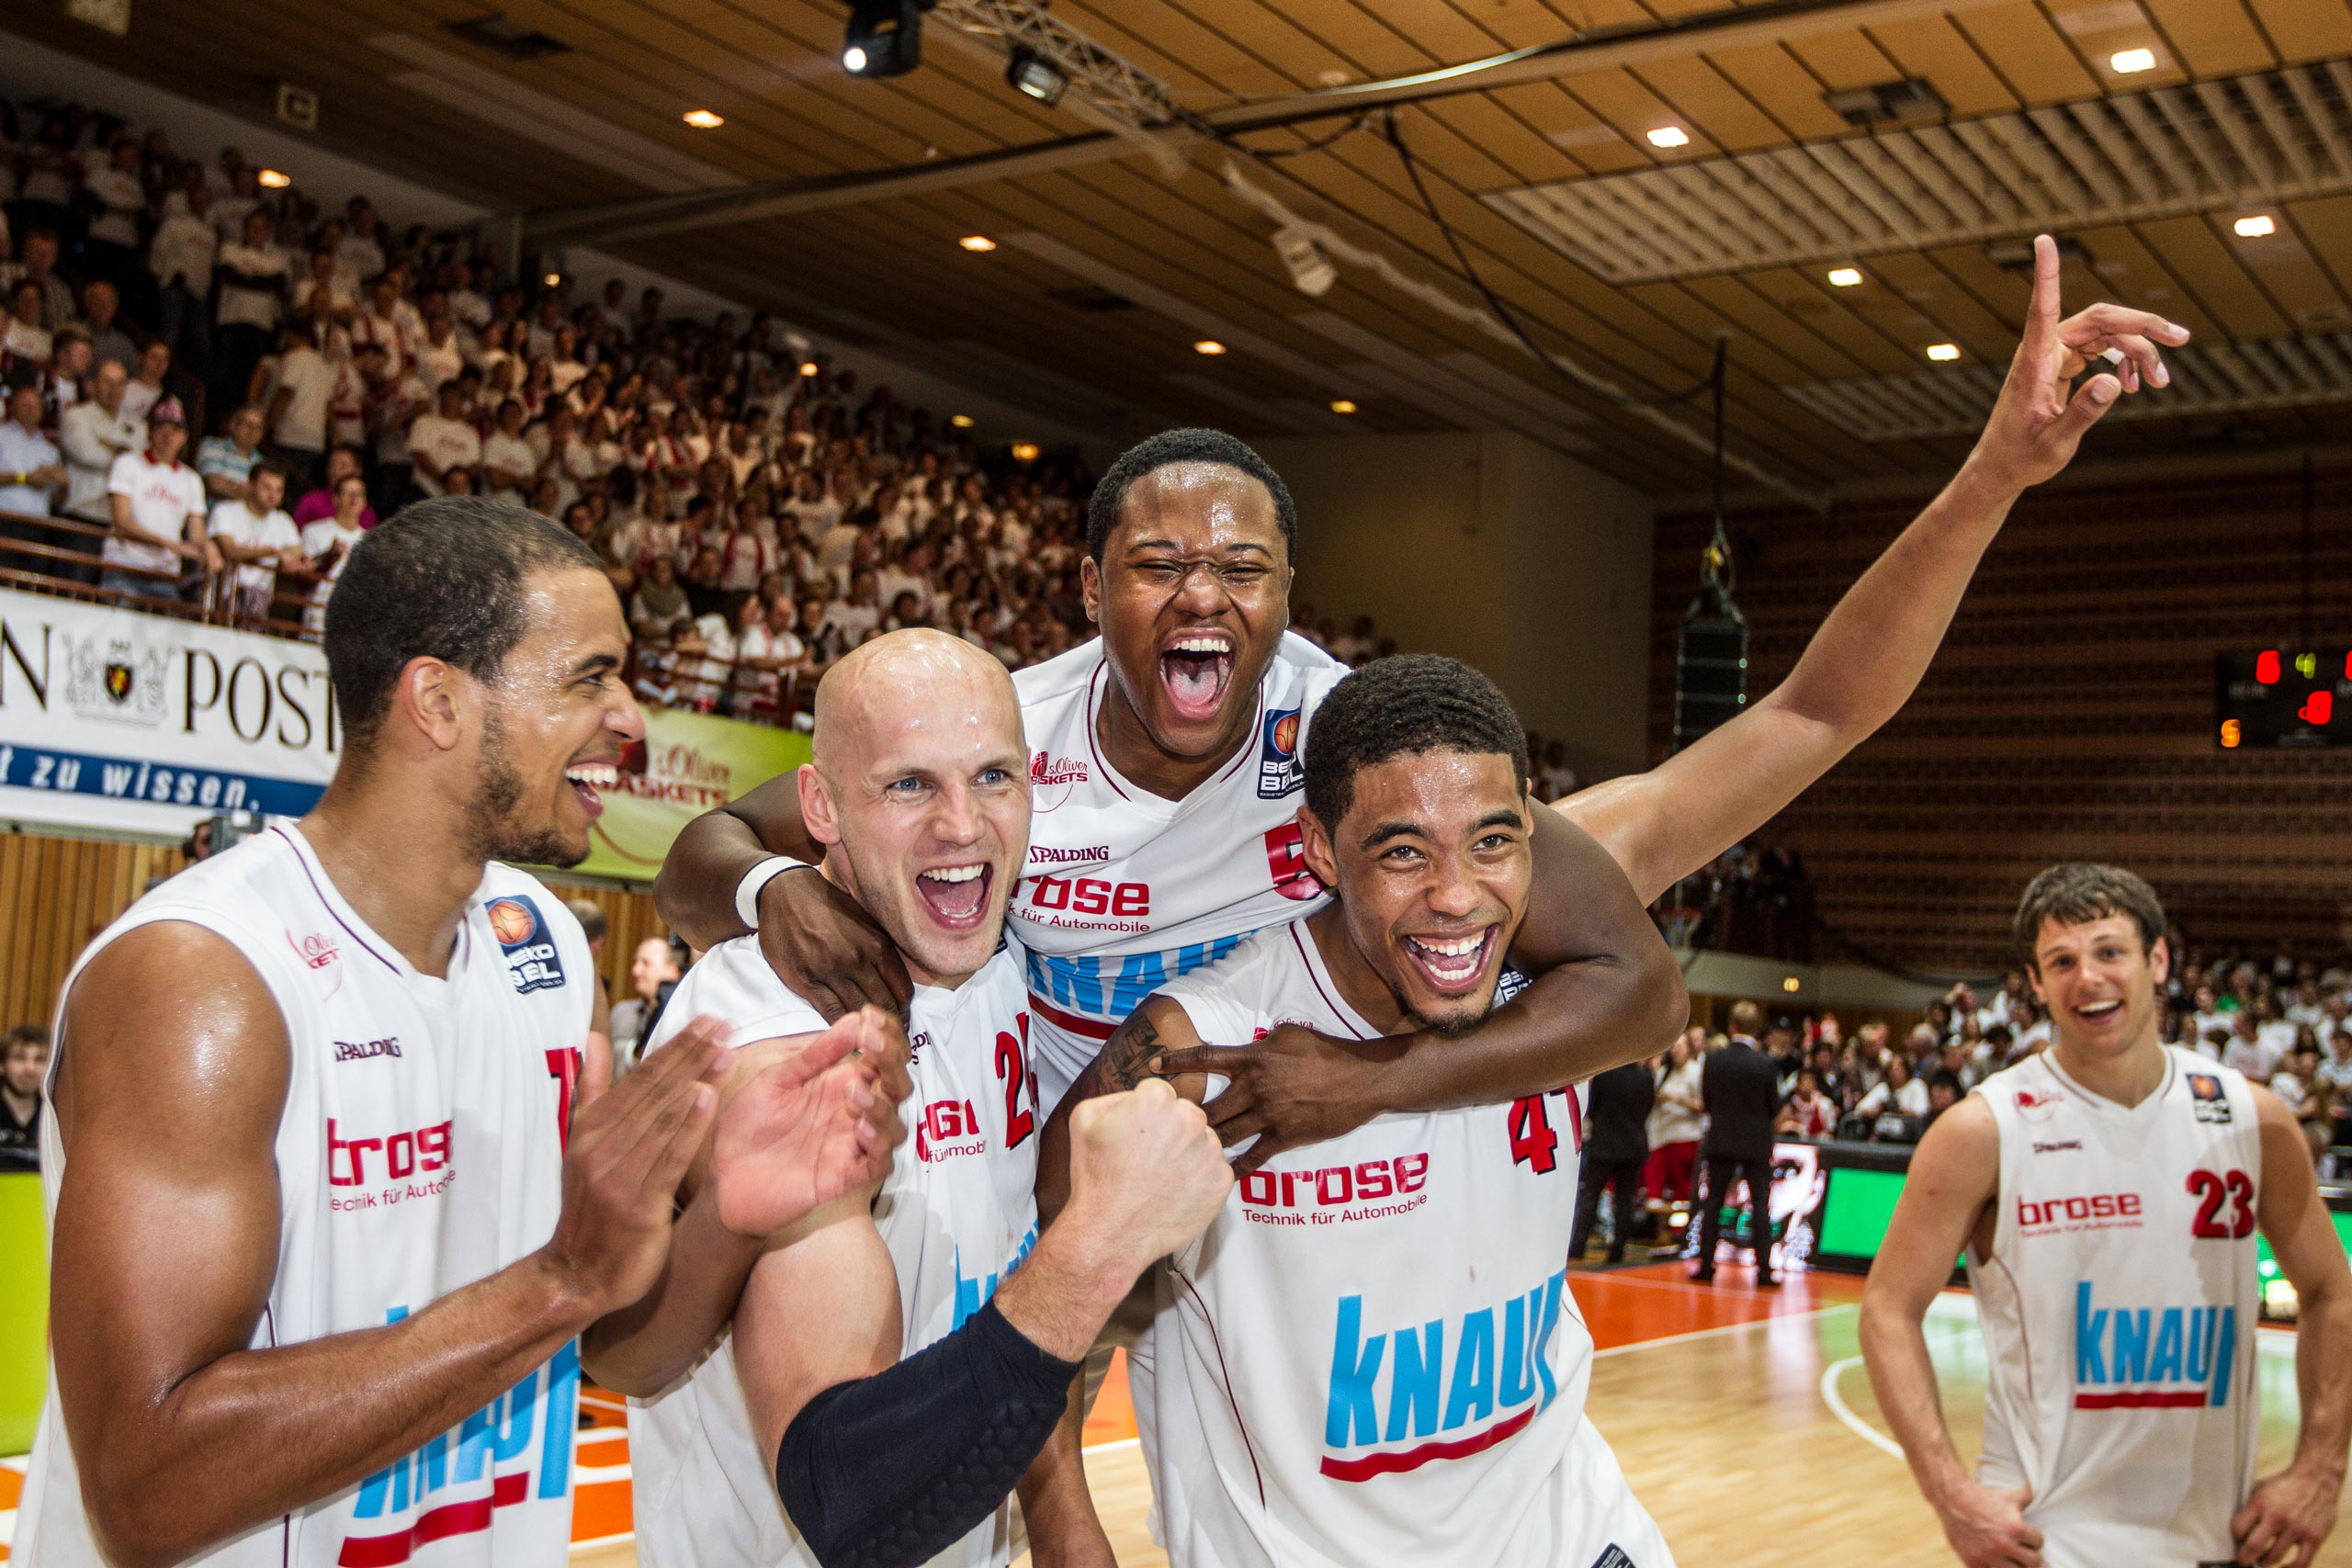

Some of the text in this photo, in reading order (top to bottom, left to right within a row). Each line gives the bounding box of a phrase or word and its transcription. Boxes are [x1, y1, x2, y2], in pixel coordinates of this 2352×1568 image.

[183, 646, 342, 753] POST
[1030, 772, 1088, 785] BSKETS
[1048, 757, 1089, 775] s.Oliver
[31, 754, 81, 792] zu
[102, 761, 261, 813] wissen.
[592, 770, 731, 808] ASKETS
[1030, 845, 1110, 863] SPALDING
[1011, 874, 1150, 917] rose
[1022, 908, 1045, 923] für
[1049, 915, 1150, 932] Automobile
[382, 1188, 402, 1206] für
[1242, 1194, 1428, 1225] Technik für Automobile
[2018, 1193, 2143, 1227] brose
[2186, 1168, 2255, 1239] 23
